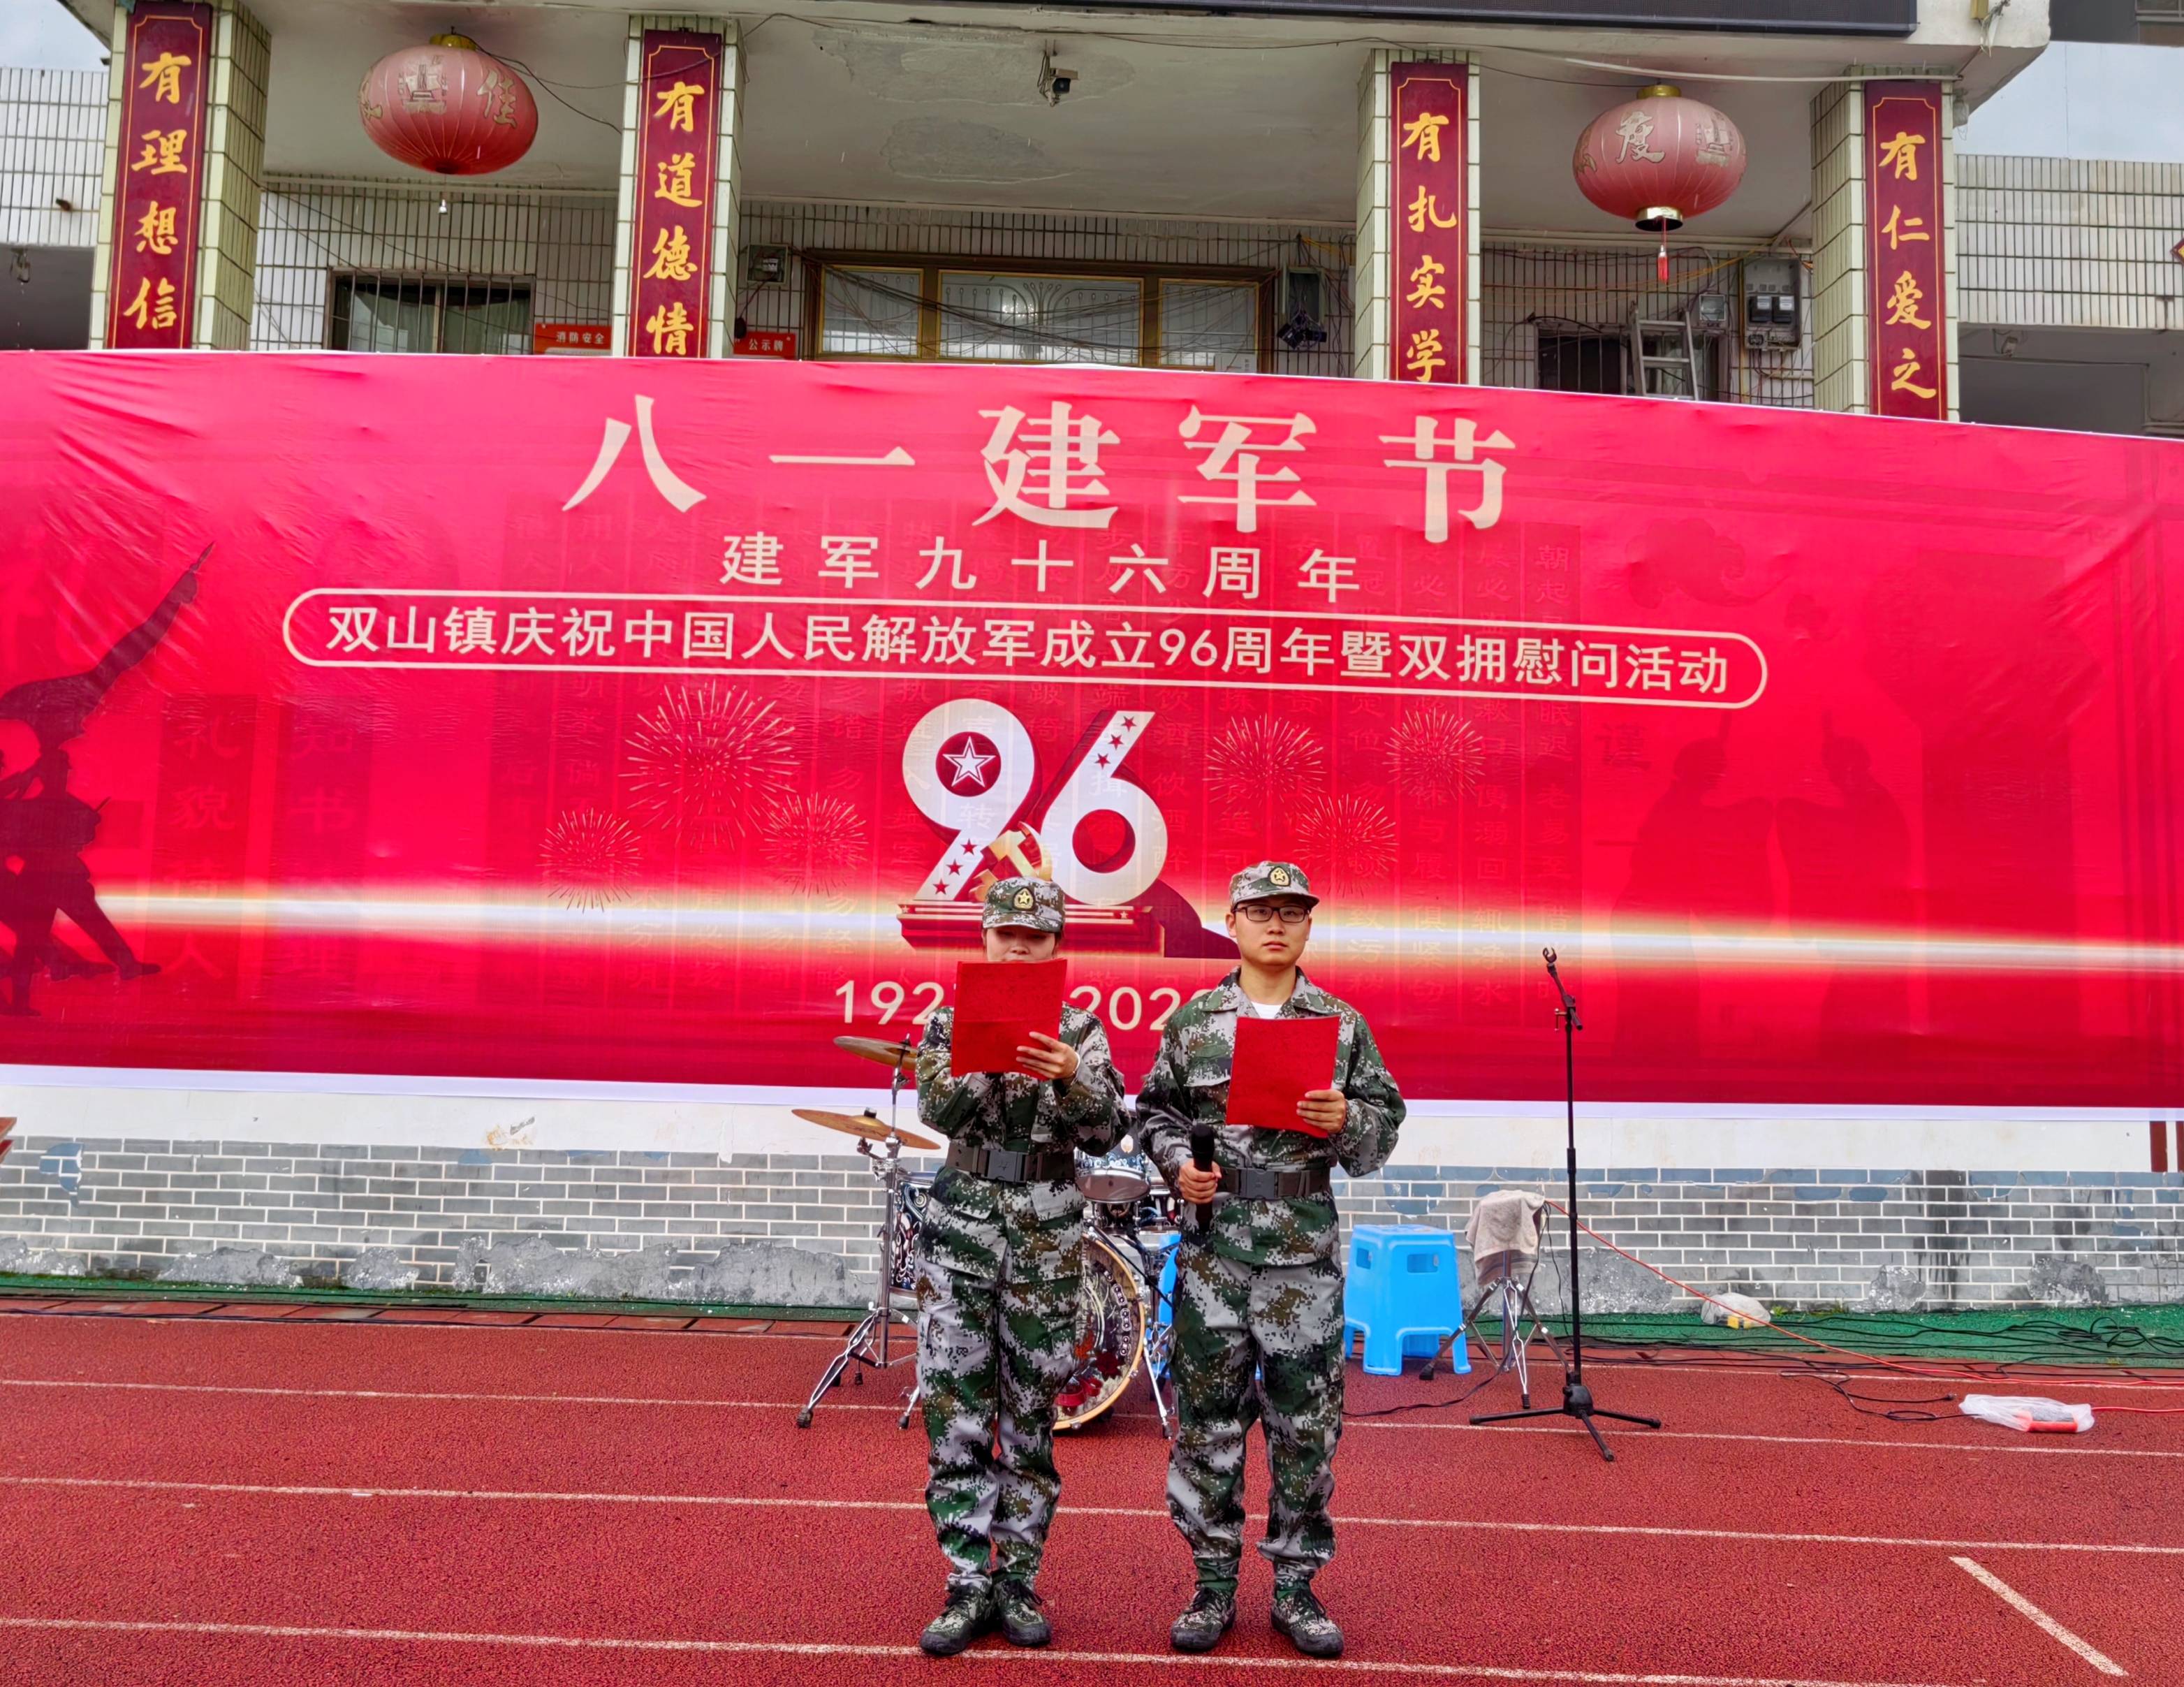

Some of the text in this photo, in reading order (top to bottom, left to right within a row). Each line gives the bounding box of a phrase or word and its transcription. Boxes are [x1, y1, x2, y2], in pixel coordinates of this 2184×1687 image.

[124, 52, 192, 330] 有理想信
[643, 81, 705, 355] 有道德情
[1401, 112, 1458, 382] 有扎实学
[1878, 131, 1937, 399] 有仁爱之
[556, 331, 604, 344] 消防安全
[562, 394, 1516, 543] 八一建军节
[719, 531, 1360, 602] 建军九十六周年
[326, 606, 1727, 694] 双山镇庆祝中国人民解放军成立96周年暨双拥慰问活动
[902, 698, 1168, 906] 96
[835, 979, 956, 1025] 192
[1069, 985, 1212, 1030] 202
